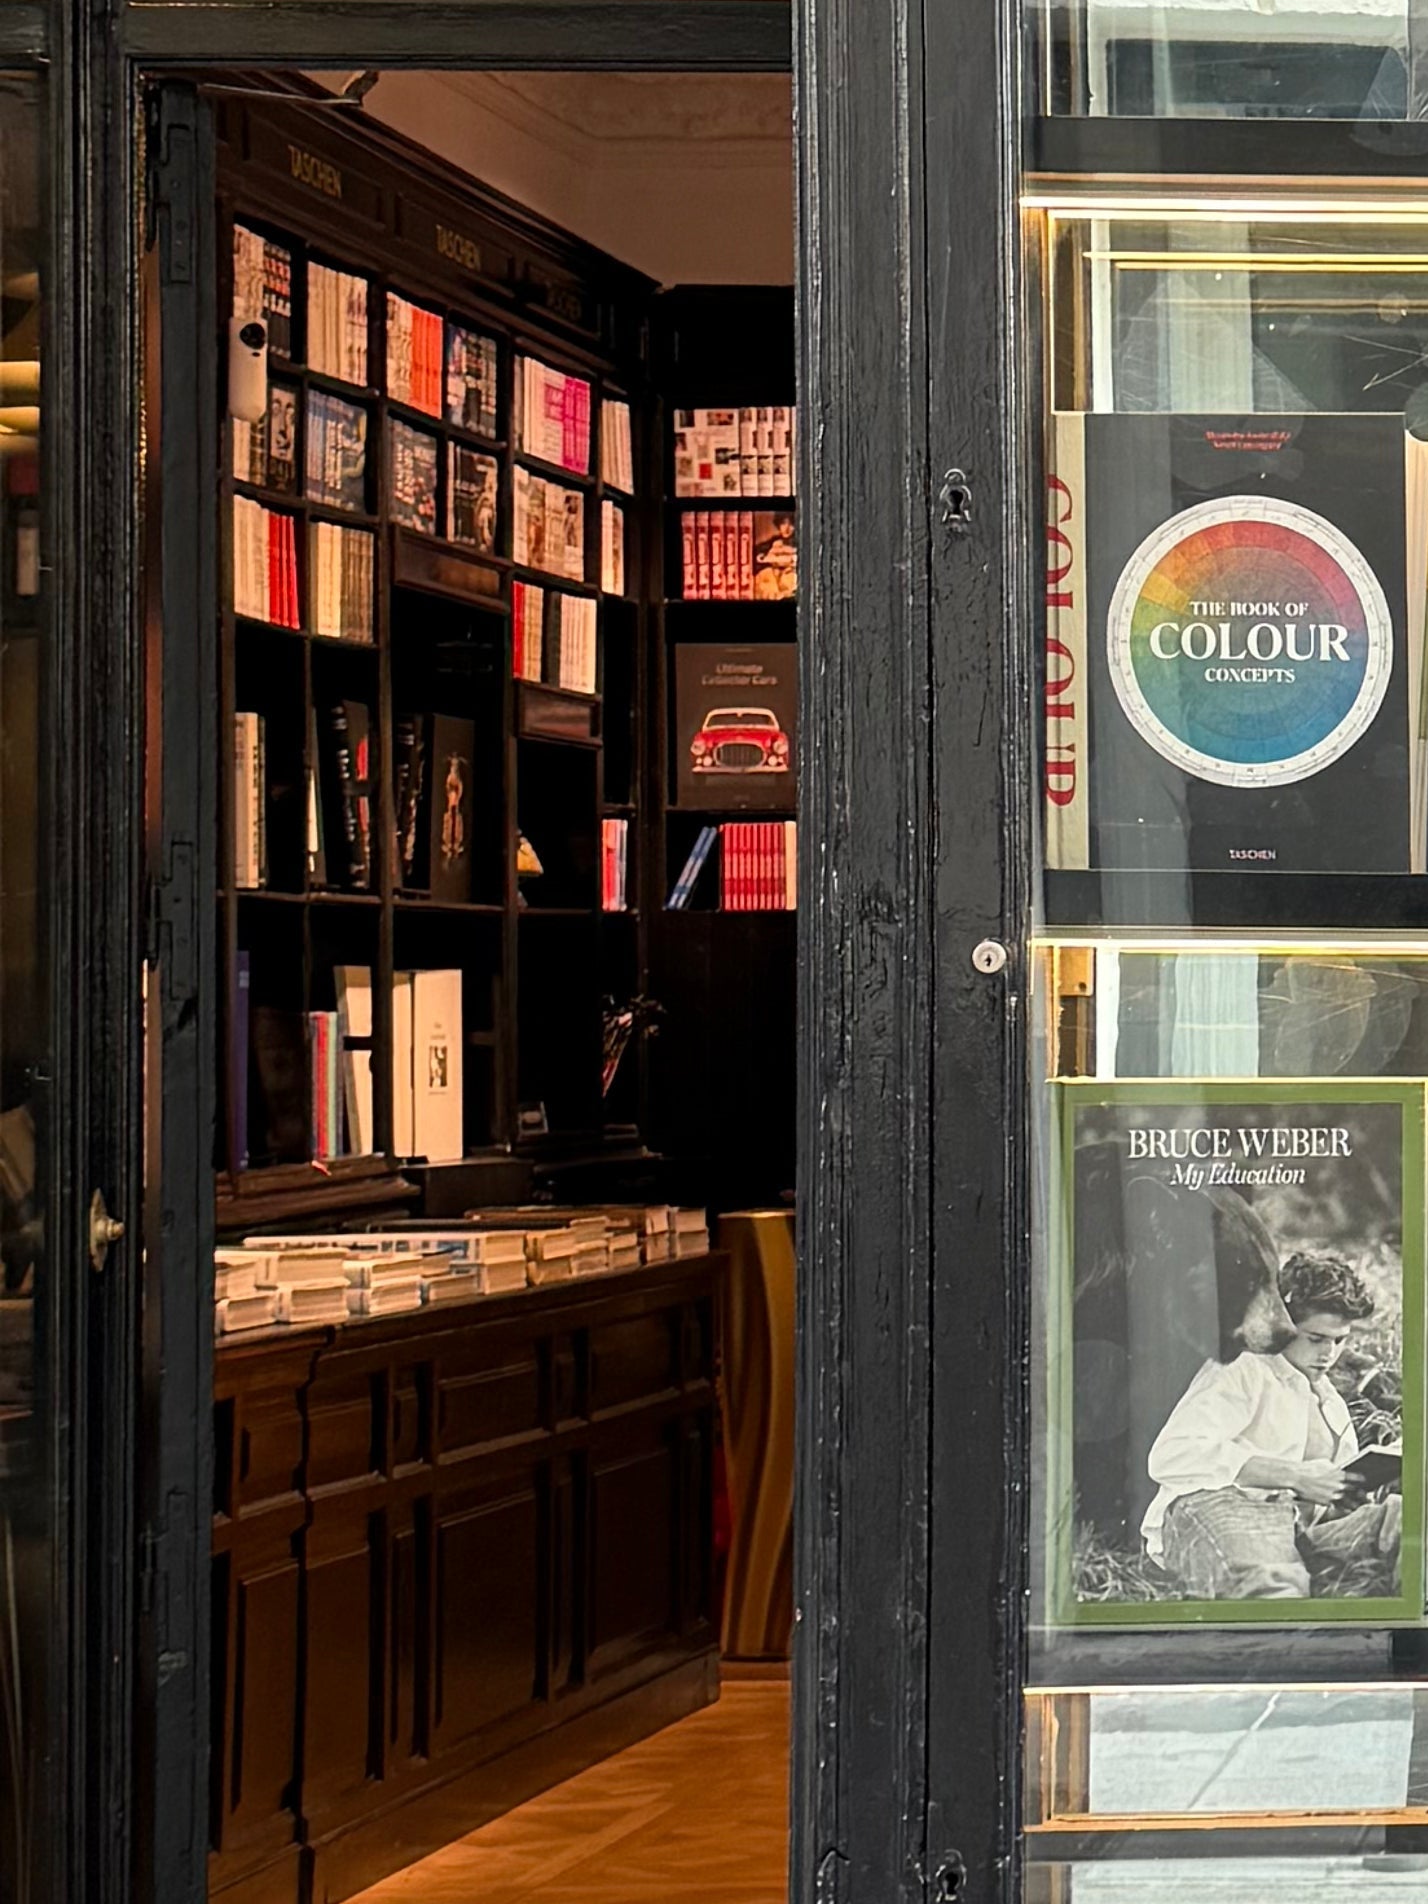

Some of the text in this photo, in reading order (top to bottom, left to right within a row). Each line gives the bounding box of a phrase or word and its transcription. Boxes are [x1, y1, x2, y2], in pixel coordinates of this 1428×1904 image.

[1189, 601, 1310, 617] THE BOOK OF
[1148, 622, 1352, 663] COLOUR
[1204, 667, 1296, 684] CONCEPTS
[1127, 1127, 1353, 1160] BRUCE WEBER
[1169, 1162, 1307, 1191] My Education
